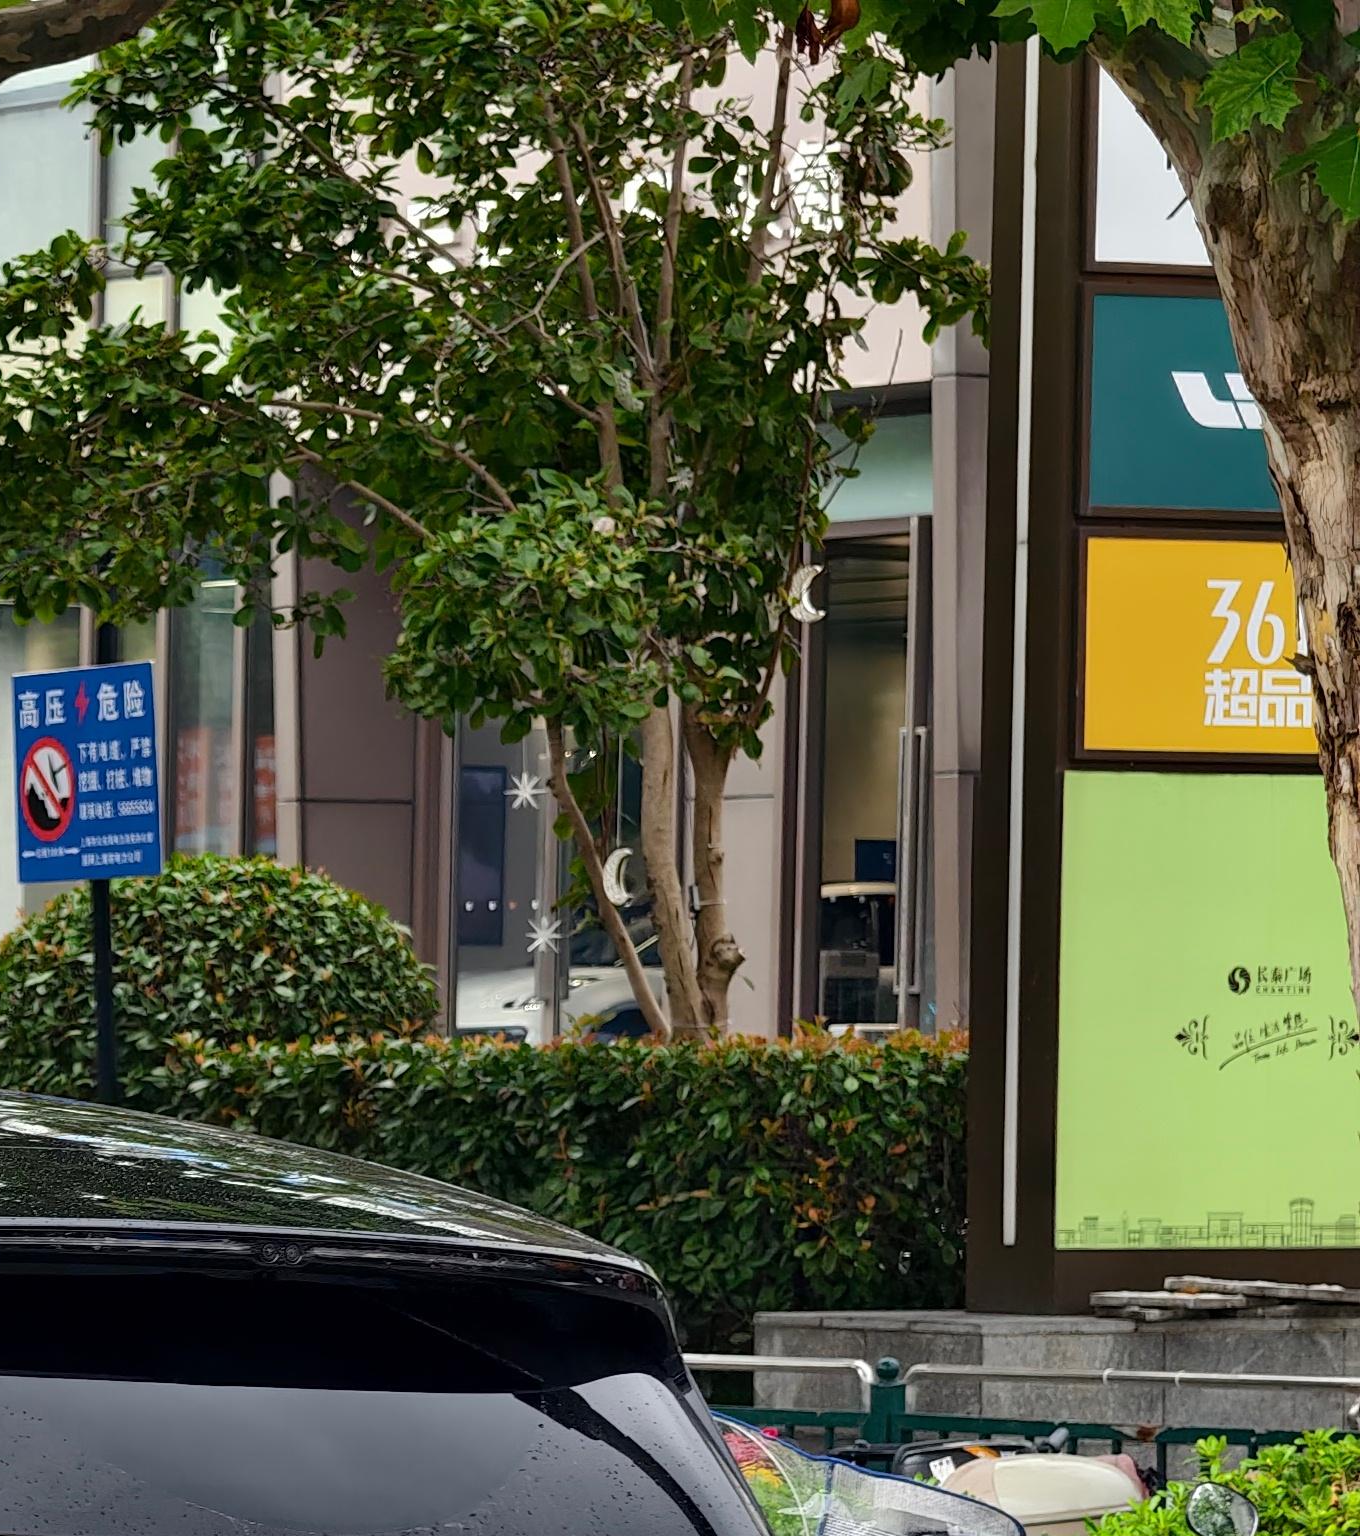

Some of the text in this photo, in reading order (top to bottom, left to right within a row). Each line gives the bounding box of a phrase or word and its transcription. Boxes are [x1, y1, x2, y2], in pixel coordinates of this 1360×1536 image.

[1206, 579, 1309, 665] 36
[18, 680, 146, 729] 高压 危险
[1257, 966, 1312, 984] 长泰广场
